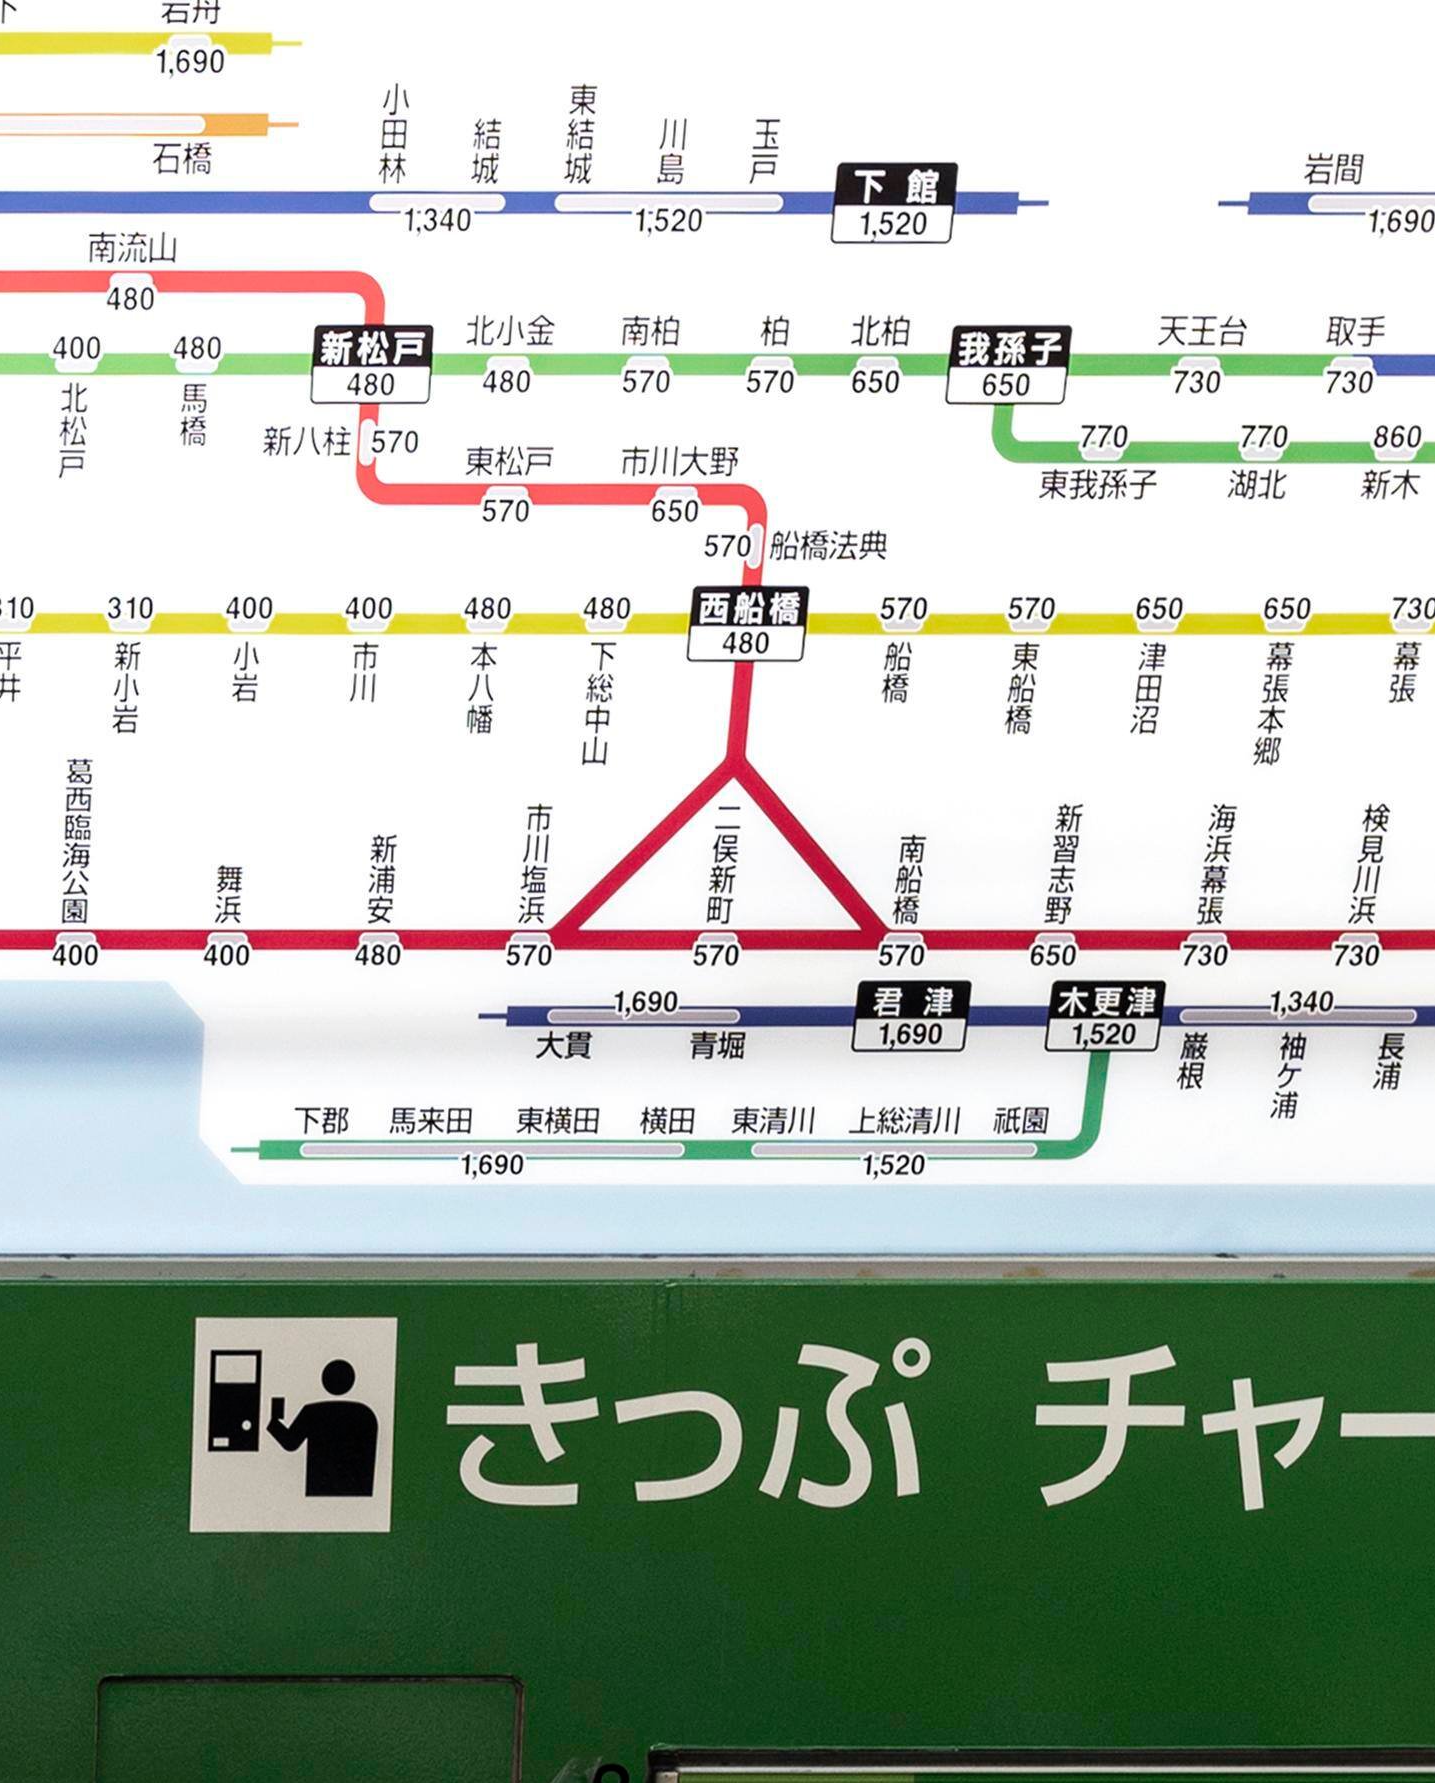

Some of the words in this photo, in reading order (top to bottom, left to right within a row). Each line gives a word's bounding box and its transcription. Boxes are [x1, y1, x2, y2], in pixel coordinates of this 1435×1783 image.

[564, 84, 598, 184] 東結城
[636, 208, 703, 233] 1,520
[1369, 209, 1435, 234] 1,690
[89, 232, 176, 263] 南流山
[466, 314, 555, 346] 北小金
[1158, 316, 1247, 347] 天王台
[318, 330, 429, 370] 新松戸
[956, 331, 1067, 370] 我孫子
[622, 446, 739, 477] 市川大野
[1039, 468, 1157, 500] 東我孫子
[769, 530, 887, 561] 船橋法典
[696, 591, 803, 628] 西船橋
[706, 806, 741, 925] 二俣新町
[1197, 804, 1237, 925] 海浜幕張
[1058, 986, 1156, 1017] 木更津
[1267, 990, 1334, 1017] 1,340
[446, 1337, 931, 1508] きっぷ
